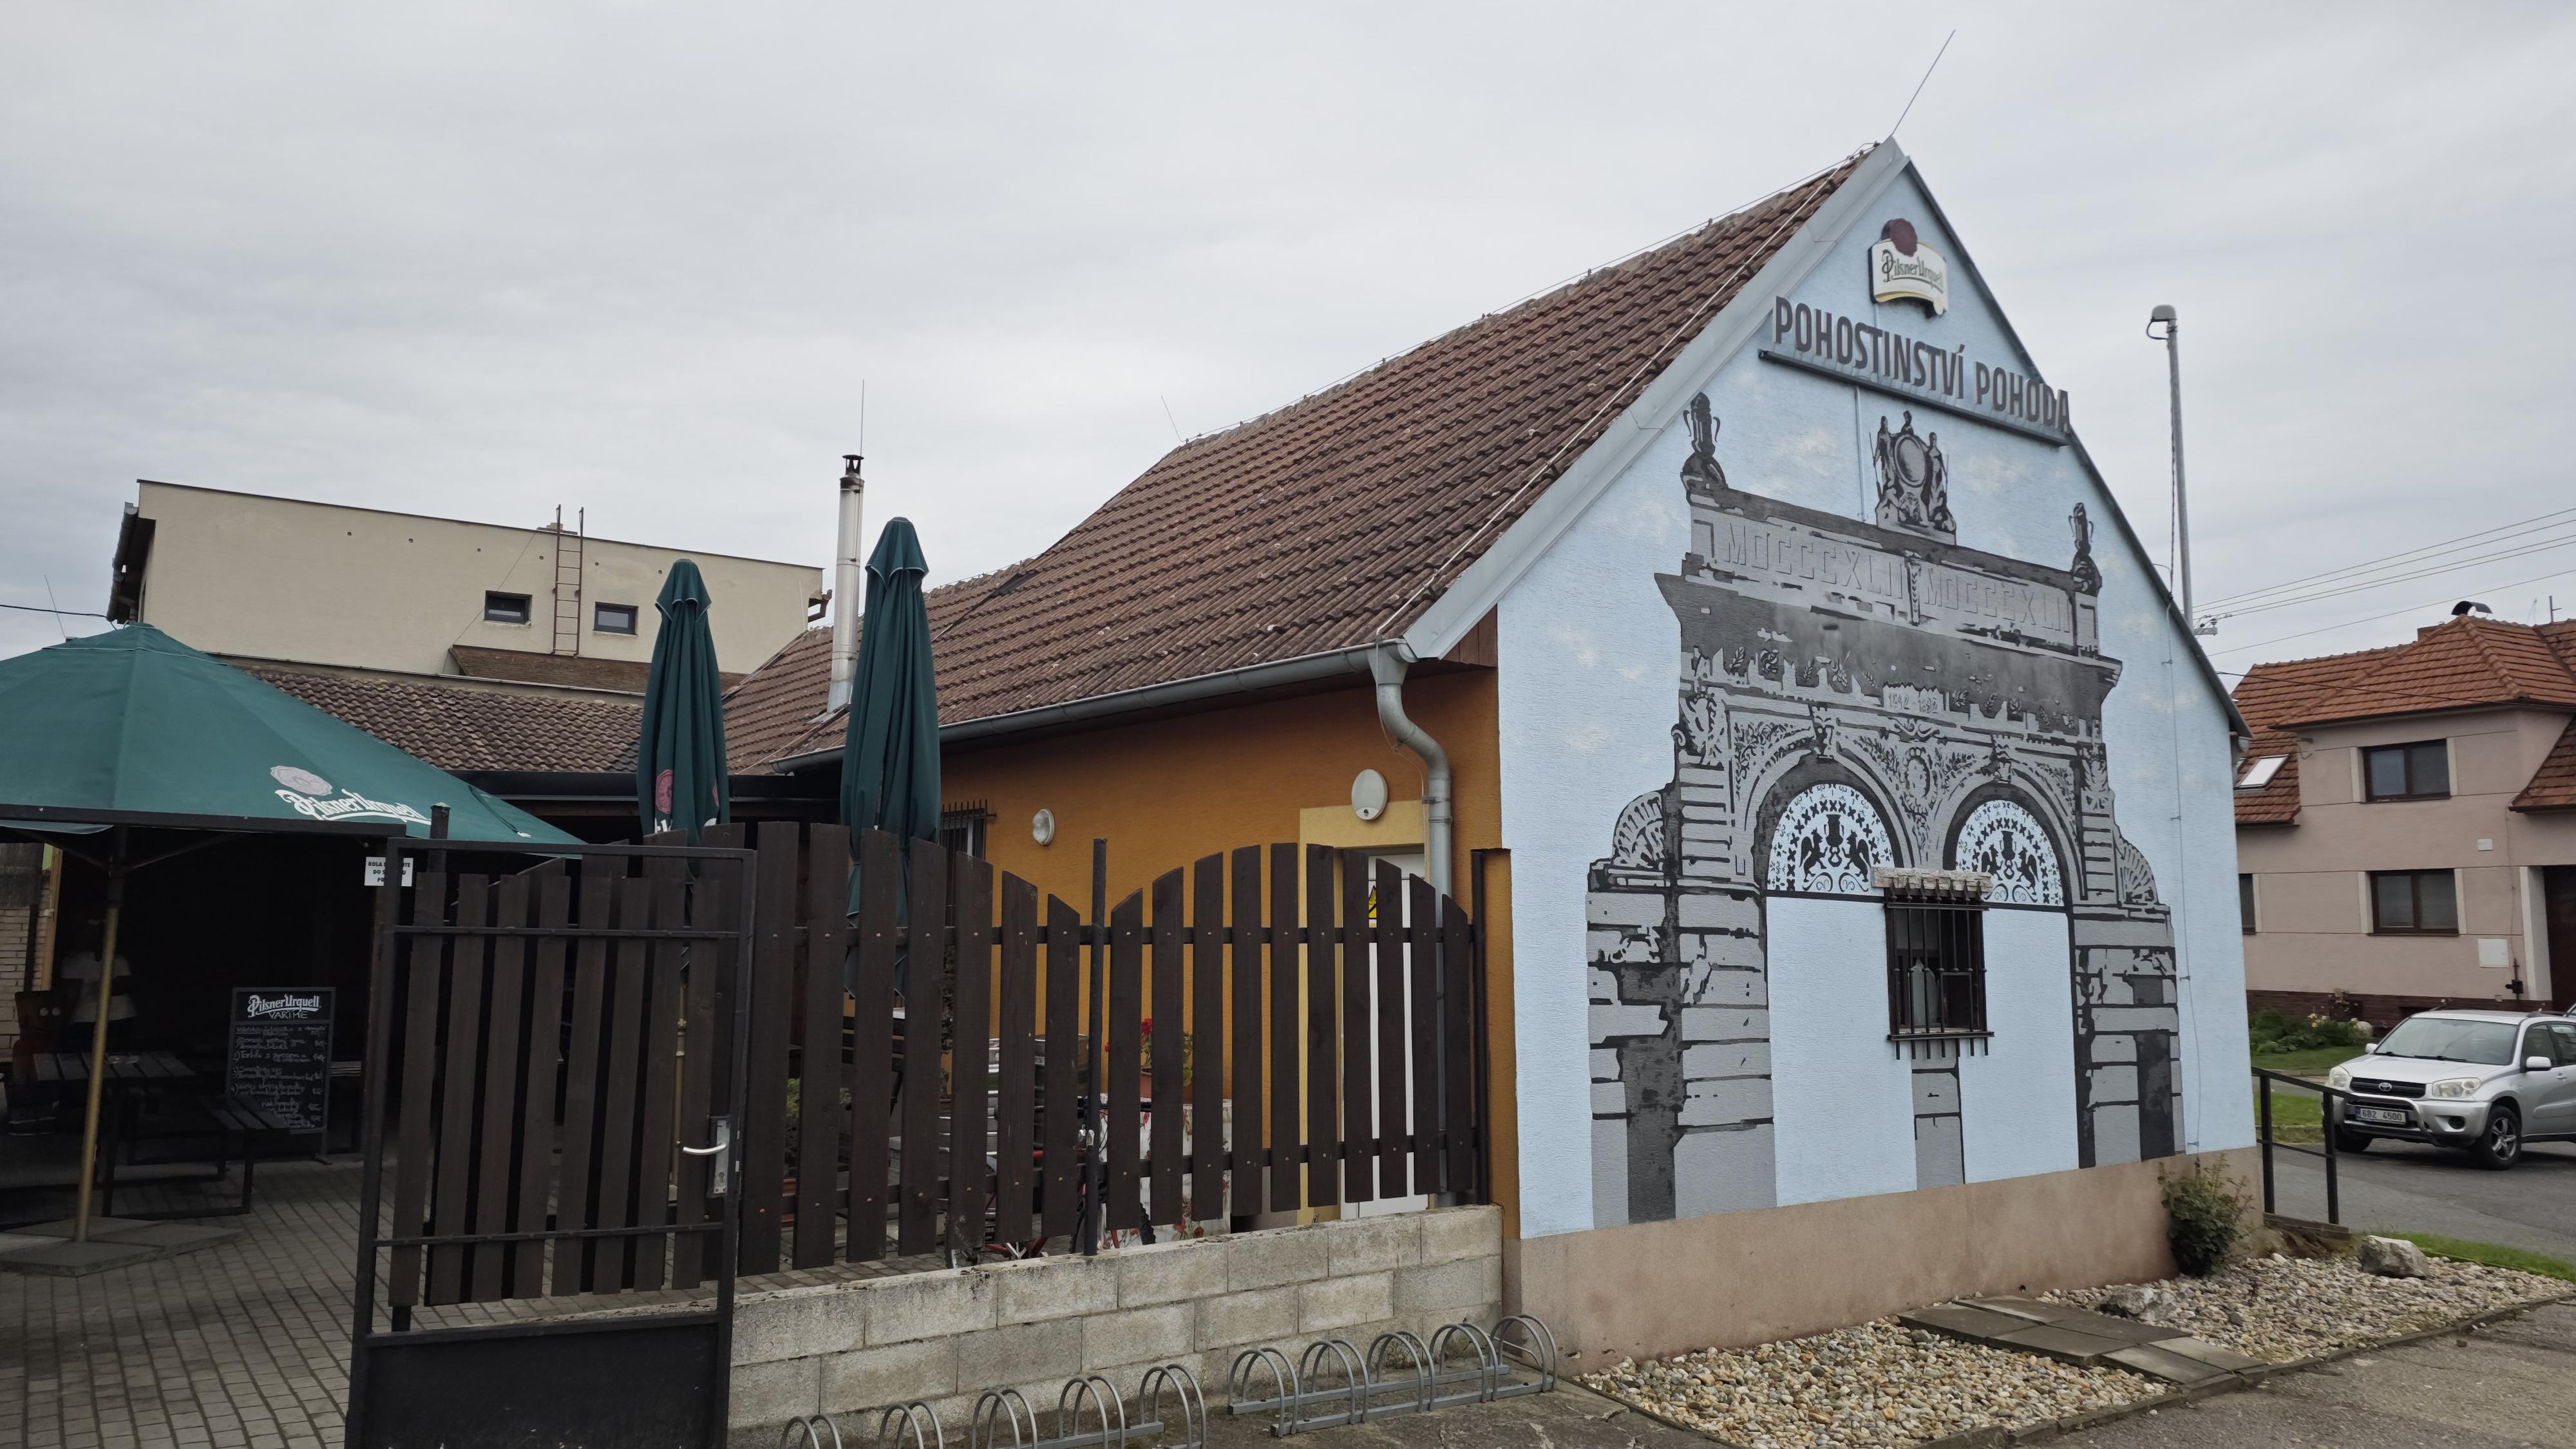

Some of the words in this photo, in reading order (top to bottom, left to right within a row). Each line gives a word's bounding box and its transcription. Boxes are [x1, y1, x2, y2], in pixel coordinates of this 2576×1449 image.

[1882, 249, 1917, 283] Pilsner
[1774, 296, 1965, 399] POHOSTINSTVÍ
[1975, 361, 2070, 430] POHODA
[275, 790, 363, 820] Pilsner
[341, 788, 430, 822] Urquell
[247, 995, 285, 1018] Pilsner
[284, 994, 319, 1012] Urquell
[2362, 1110, 2376, 1119] 6B2
